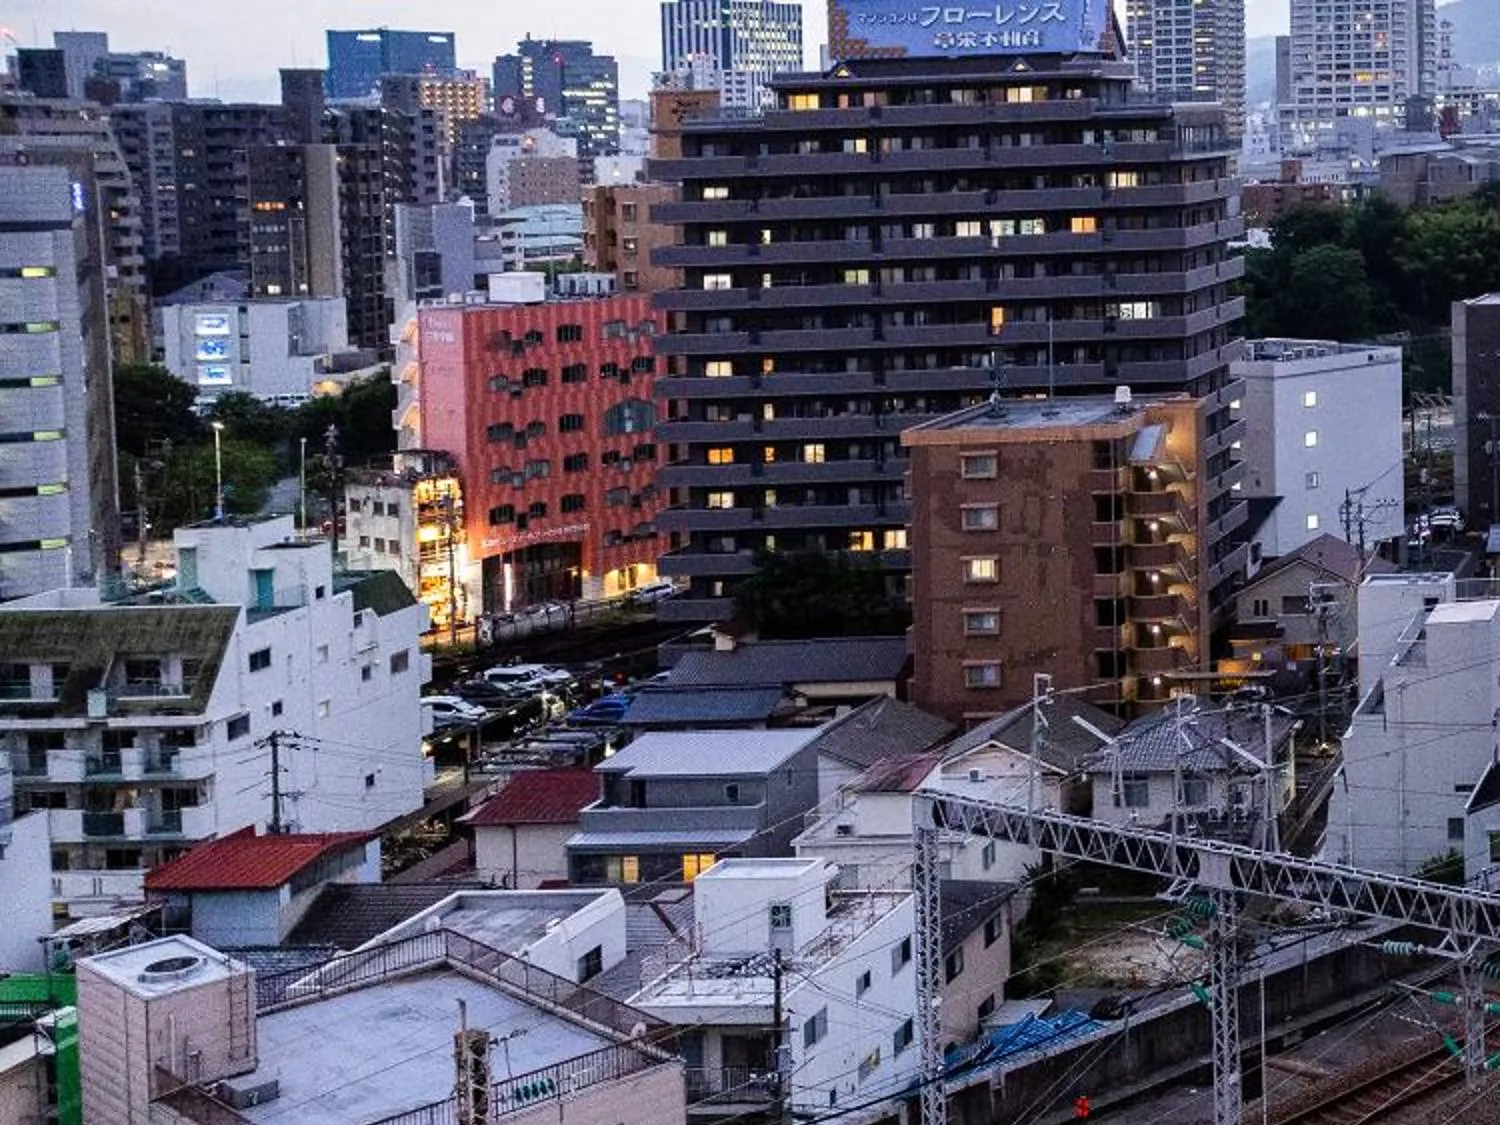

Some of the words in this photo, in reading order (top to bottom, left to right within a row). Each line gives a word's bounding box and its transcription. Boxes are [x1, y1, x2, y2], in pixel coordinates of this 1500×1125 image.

[920, 3, 1065, 27] フローレンス
